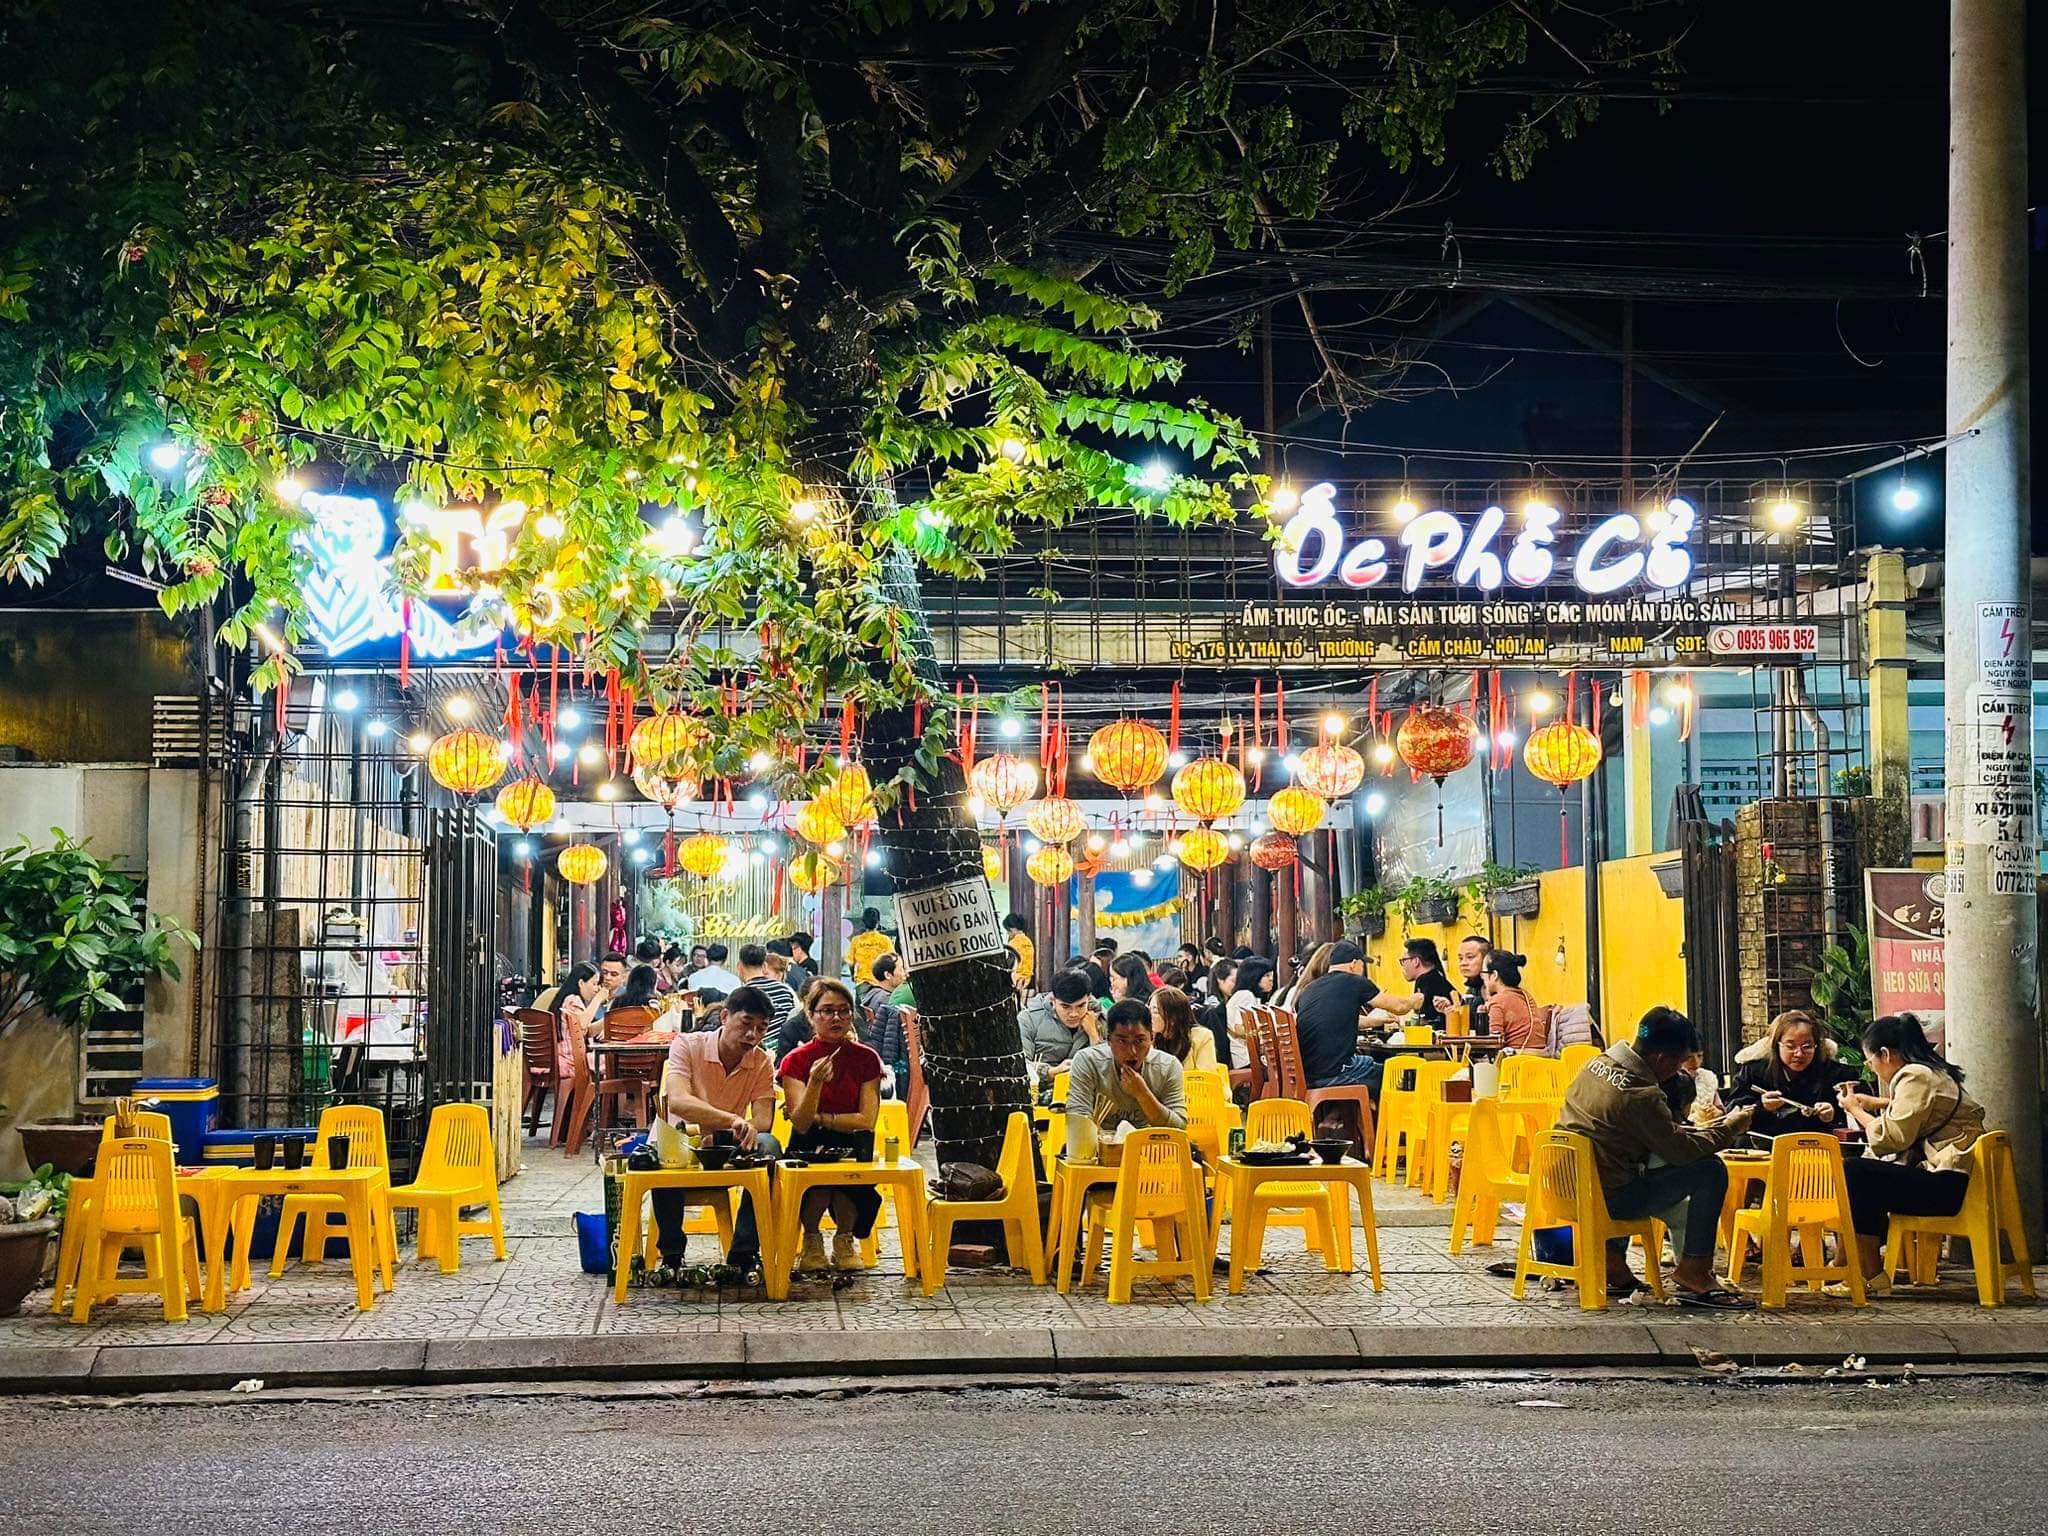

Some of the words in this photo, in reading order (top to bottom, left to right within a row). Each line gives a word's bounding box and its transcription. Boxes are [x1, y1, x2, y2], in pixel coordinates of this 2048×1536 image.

[1276, 482, 1388, 589] Ốc
[1242, 600, 1270, 626] ẨM
[1274, 606, 1319, 630] THỰC
[1323, 601, 1346, 626] ỐC
[1363, 601, 1393, 625] HẢI
[1398, 601, 1434, 625] SẢN
[1439, 604, 1477, 624] TƯƠI
[1482, 600, 1529, 624] SỐNG
[1546, 601, 1581, 623] CÁC
[1585, 601, 1626, 623] MÓN
[1631, 600, 1655, 622] ĂN
[1700, 598, 1736, 622] SẢN
[1200, 641, 1226, 658] 176
[1228, 639, 1247, 655] LÝ
[1249, 639, 1281, 655] THÁI
[1285, 636, 1303, 655] TỔ
[1318, 638, 1375, 656] TRƯỜNG
[1408, 634, 1440, 656] CẨM
[1444, 637, 1482, 655] CHÂU
[1495, 636, 1520, 658] HỘI
[1525, 639, 1545, 655] AN
[1610, 636, 1643, 652] NAM
[1675, 636, 1705, 652] SĐT:
[1737, 629, 1765, 650] 0935
[1769, 629, 1790, 650] 965
[1793, 629, 1815, 650] 952
[911, 897, 937, 917] VUI
[940, 889, 978, 911] LÒNG
[908, 916, 961, 941] KHÔNG
[963, 907, 990, 929] BÁN
[913, 941, 957, 963] HÀNG
[960, 932, 996, 954] RONG
[1910, 946, 1945, 966] NHẬ
[1883, 970, 1905, 993] HEO
